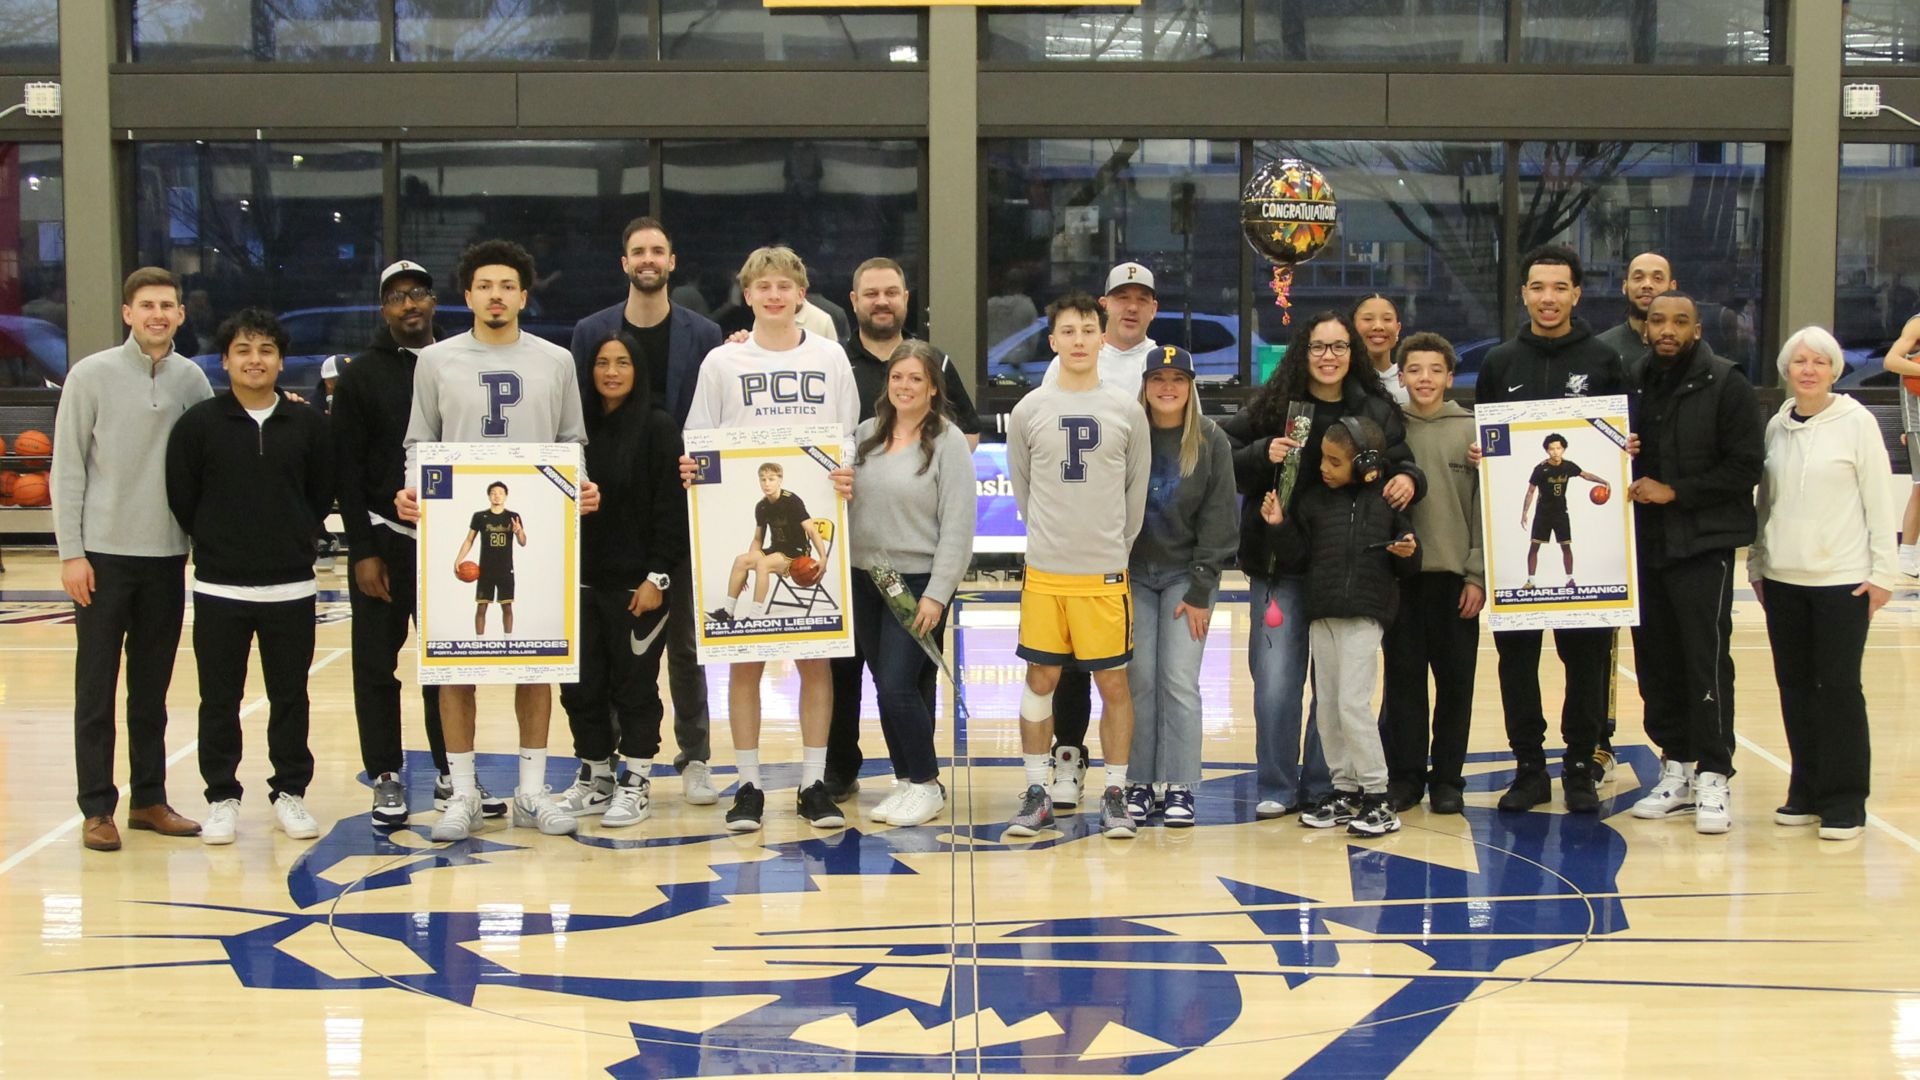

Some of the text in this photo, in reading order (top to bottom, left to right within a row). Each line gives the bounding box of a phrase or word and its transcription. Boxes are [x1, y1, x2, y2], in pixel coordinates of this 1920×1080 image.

[1128, 267, 1137, 280] P
[1163, 346, 1177, 364] P
[738, 371, 826, 406] PCC
[478, 370, 523, 438] P
[755, 406, 817, 416] ATHLETICS
[1059, 415, 1101, 482] P
[1486, 429, 1500, 453] P
[808, 446, 836, 470] #GOPANTHE
[695, 455, 710, 480] P
[426, 469, 442, 495] P
[1553, 484, 1562, 496] 5
[490, 532, 506, 547] 20
[1495, 586, 1627, 598] #5 CHARLES MANIGO
[704, 616, 839, 631] #11 AARON LIEBELT
[427, 640, 567, 649] #20 VASHON HARDGES
